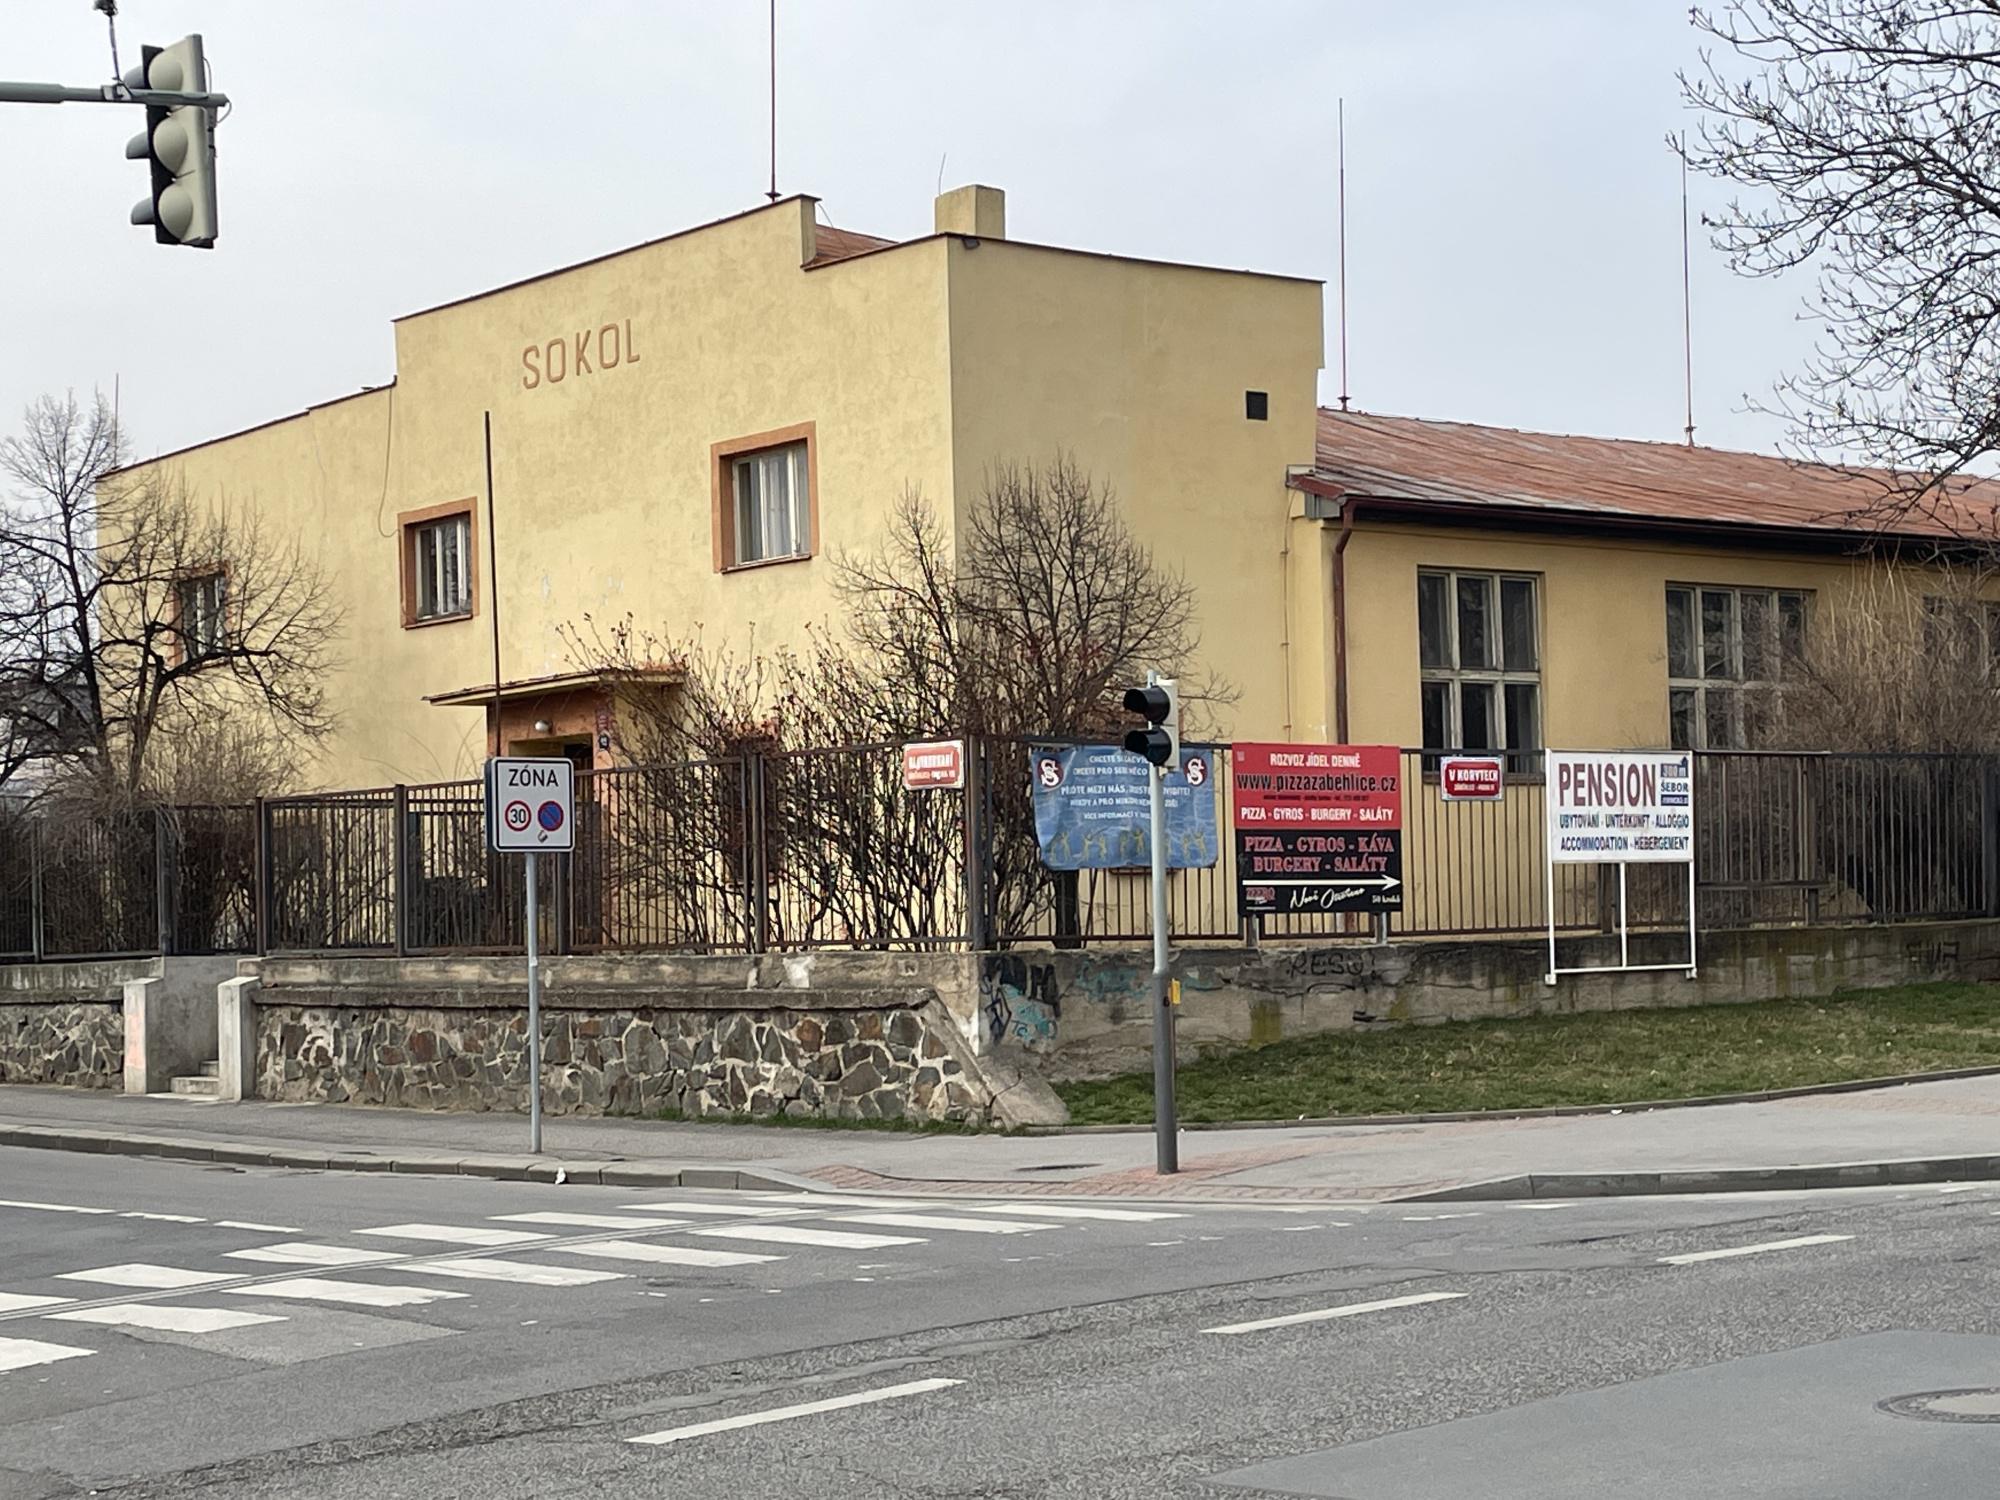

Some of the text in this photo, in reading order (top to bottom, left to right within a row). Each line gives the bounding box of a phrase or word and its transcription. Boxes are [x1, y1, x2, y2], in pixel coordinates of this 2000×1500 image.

[522, 318, 640, 390] SOKOL
[1270, 752, 1361, 768] ROZVOZ JÍDEL DENNĚ
[508, 764, 559, 787] ZÓNA
[1237, 773, 1396, 792] www.pizzazabehlice.cz
[1558, 763, 1656, 807] PENSION
[1660, 780, 1689, 792] ŠEBOR
[510, 808, 526, 824] 30
[1241, 808, 1266, 820] PIZZA
[1273, 808, 1304, 820] GYROS
[1310, 808, 1352, 821] BURGERY
[1359, 806, 1393, 821] SALÁTY
[1559, 812, 1600, 828] UBYTOVÁNÍ
[1605, 814, 1650, 828] UNTERKUNFT
[1244, 836, 1284, 852] PIZZA
[1296, 836, 1346, 852] GYROS
[1358, 832, 1394, 852] KÁVA
[1561, 836, 1629, 851] ACCOMMODATION
[1634, 836, 1689, 851] HEBERGEMENT
[1254, 856, 1322, 872] BURGERY
[1334, 852, 1388, 872] SALÁTY
